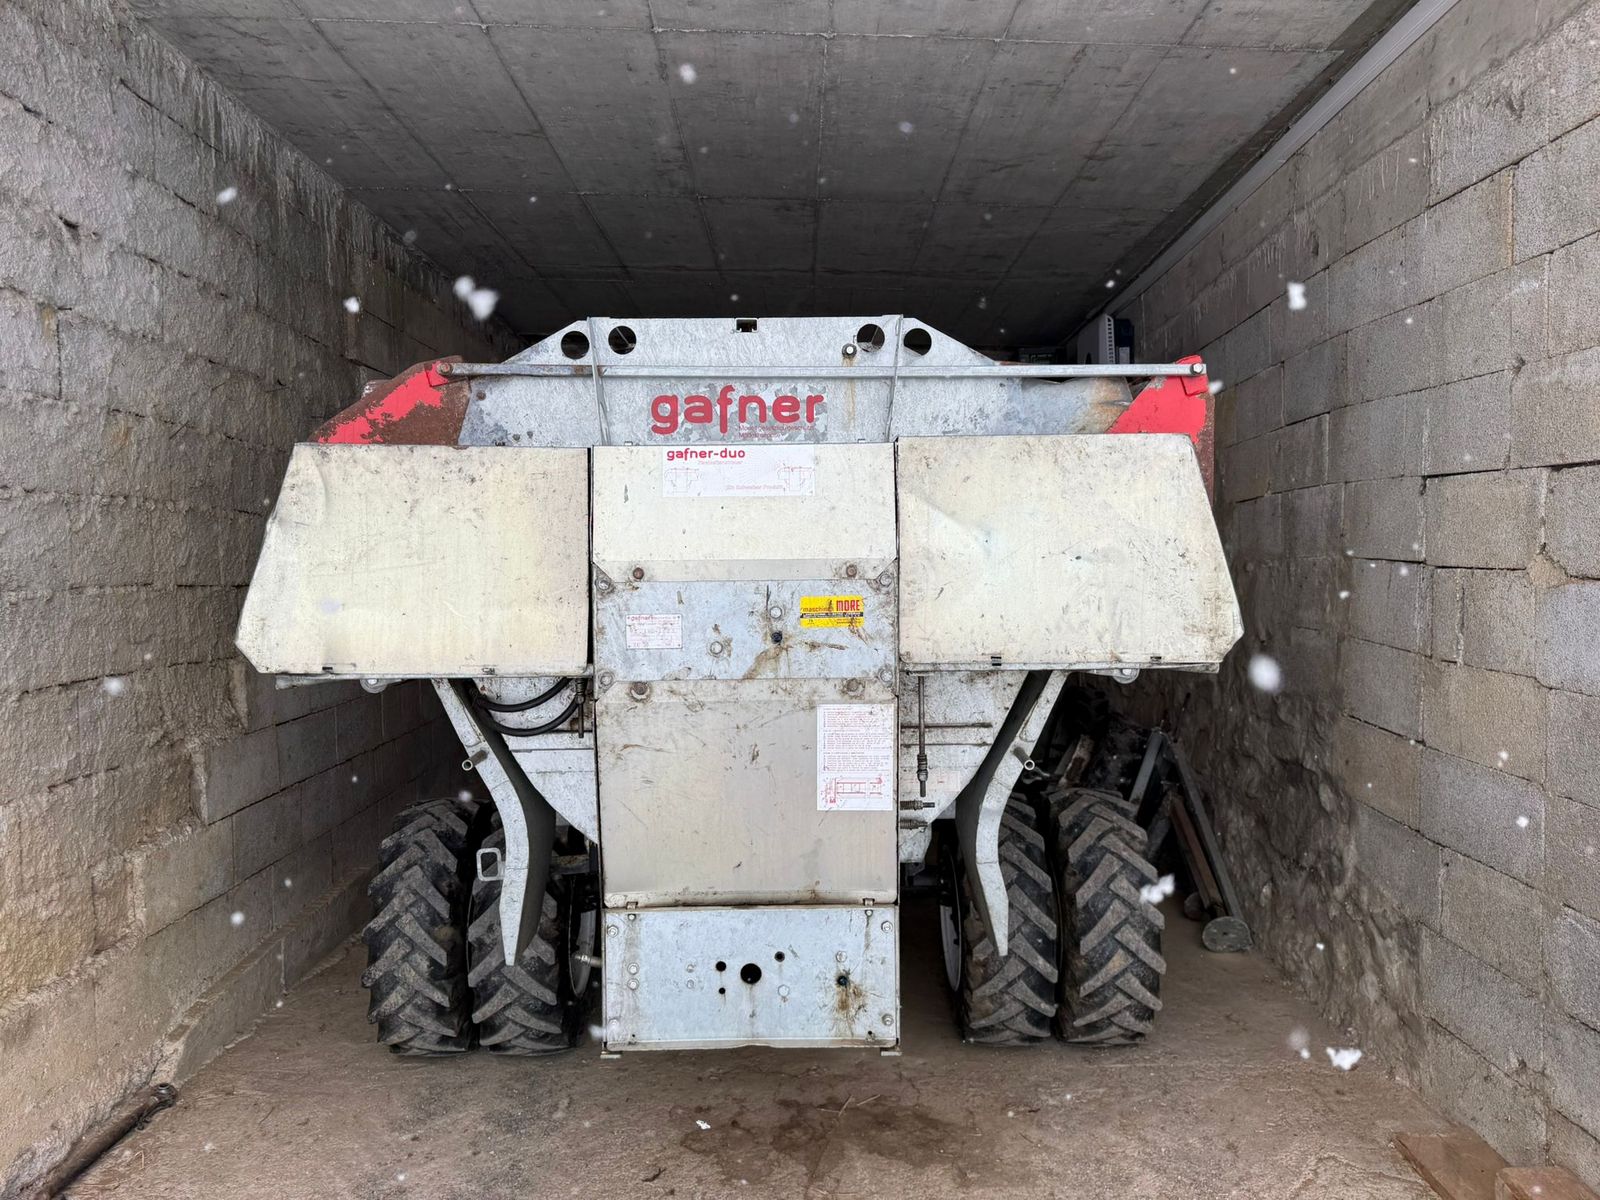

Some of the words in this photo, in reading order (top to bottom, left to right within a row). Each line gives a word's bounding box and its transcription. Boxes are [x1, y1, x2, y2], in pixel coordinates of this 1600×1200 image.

[651, 385, 824, 434] gafner
[667, 448, 745, 460] gafner-duo
[836, 600, 860, 611] MORE
